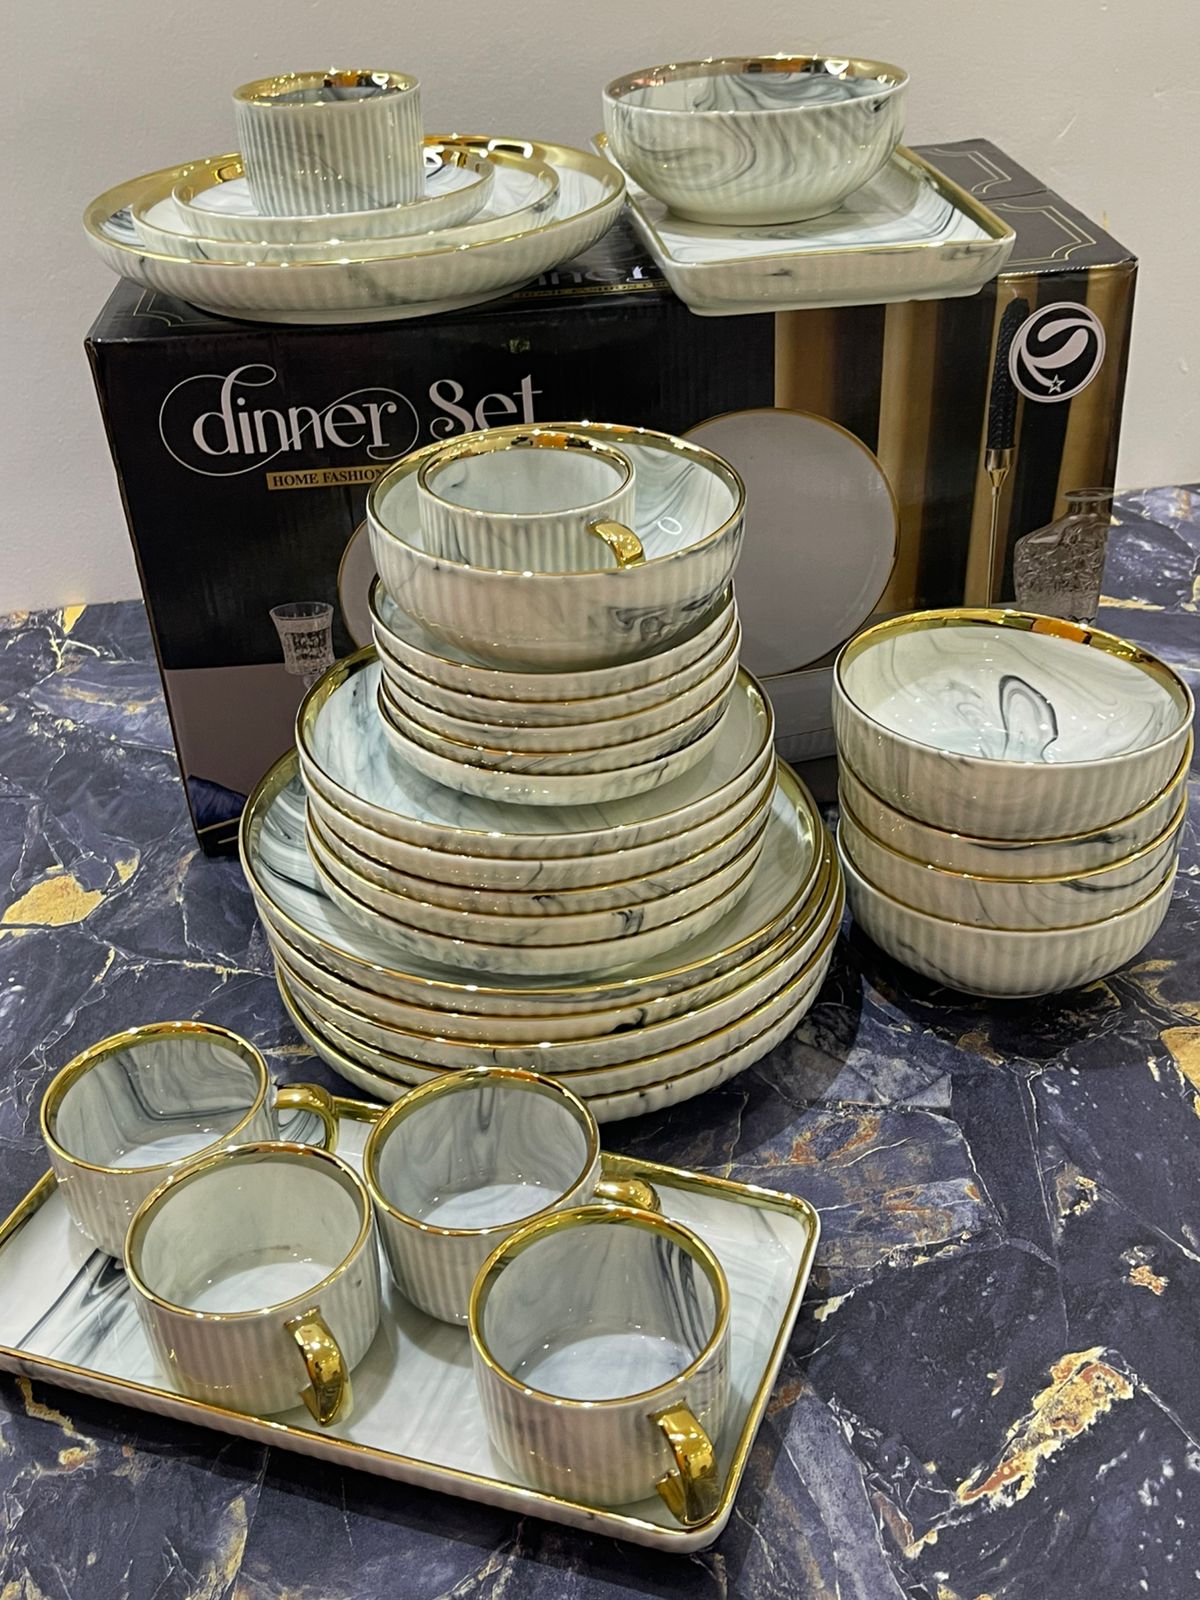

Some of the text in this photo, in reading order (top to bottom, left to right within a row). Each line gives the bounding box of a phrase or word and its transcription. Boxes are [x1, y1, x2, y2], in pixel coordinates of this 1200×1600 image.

[158, 363, 543, 477] dinner Set
[272, 473, 319, 487] HOME
